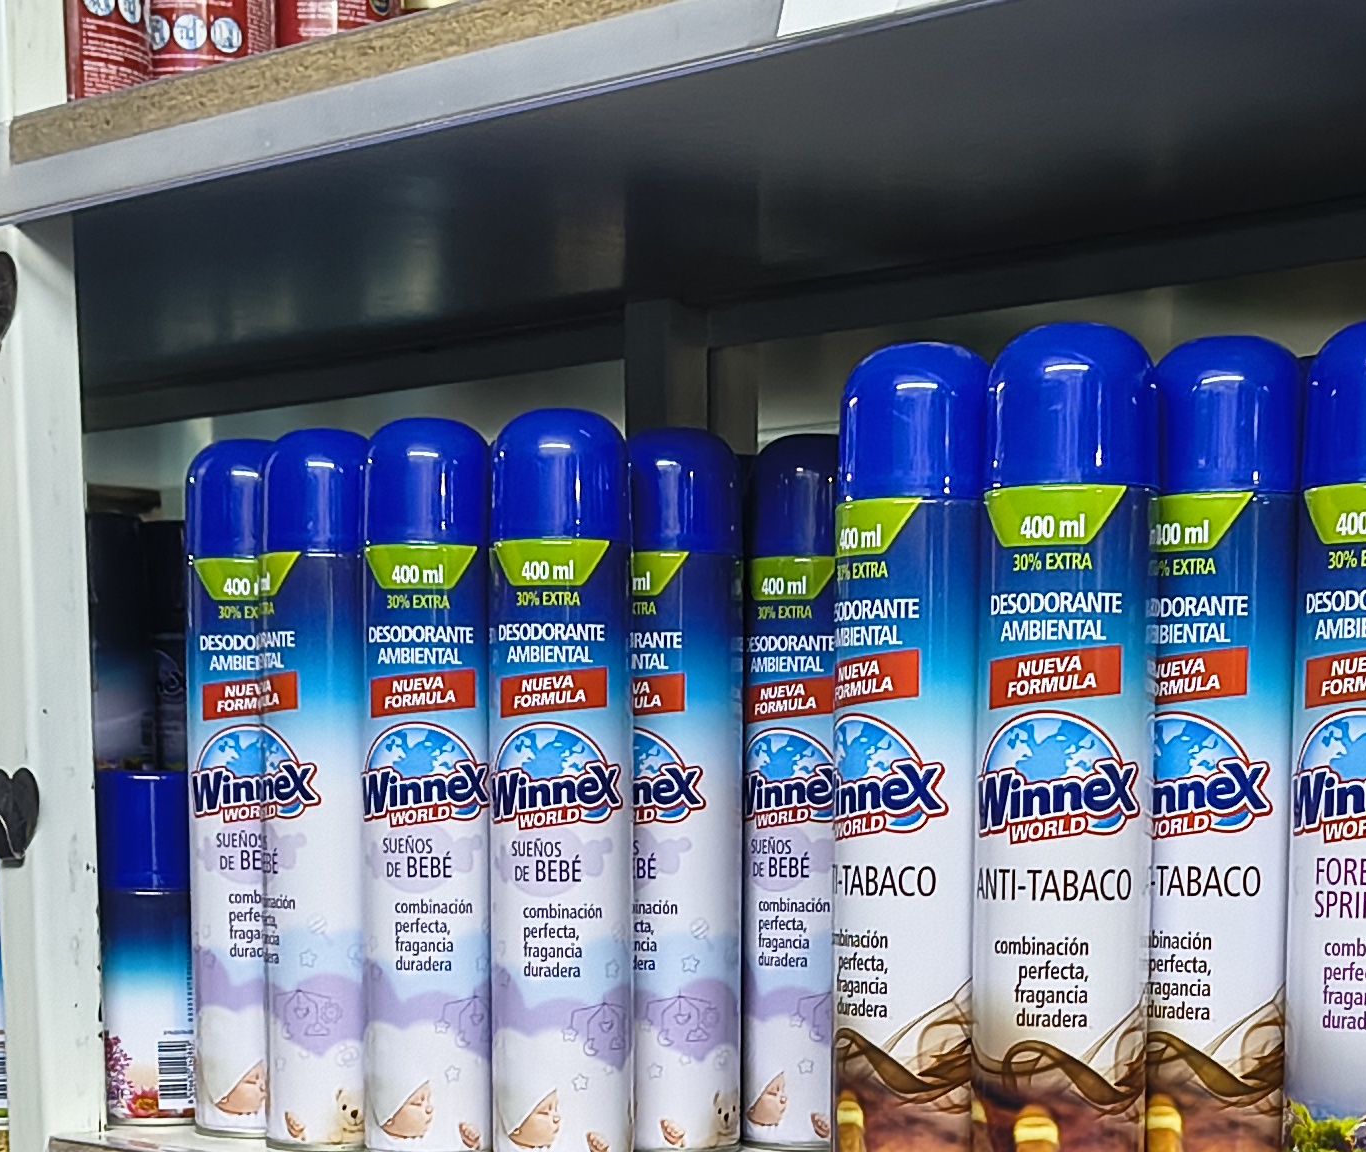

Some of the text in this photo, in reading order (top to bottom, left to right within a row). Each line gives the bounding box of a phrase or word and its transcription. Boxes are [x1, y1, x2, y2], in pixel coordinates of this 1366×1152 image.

[1020, 513, 1086, 539] 400 ml
[521, 559, 574, 581] 400 ml
[1327, 550, 1357, 569] 30%
[990, 591, 1123, 616] DESODORANTE
[498, 623, 605, 643] DESODORANTE
[1000, 619, 1107, 642] AMBIENTAL
[507, 645, 593, 663] AMBIENTAL
[1017, 655, 1083, 678] NUEVA
[1007, 672, 1097, 698] FORMULA
[519, 805, 581, 830] WORLD
[1010, 817, 1086, 844] WORLD
[511, 838, 562, 857] SUEÑOS
[514, 855, 582, 883] DE BEBÉ
[976, 868, 1132, 902] ANTI-TABACO
